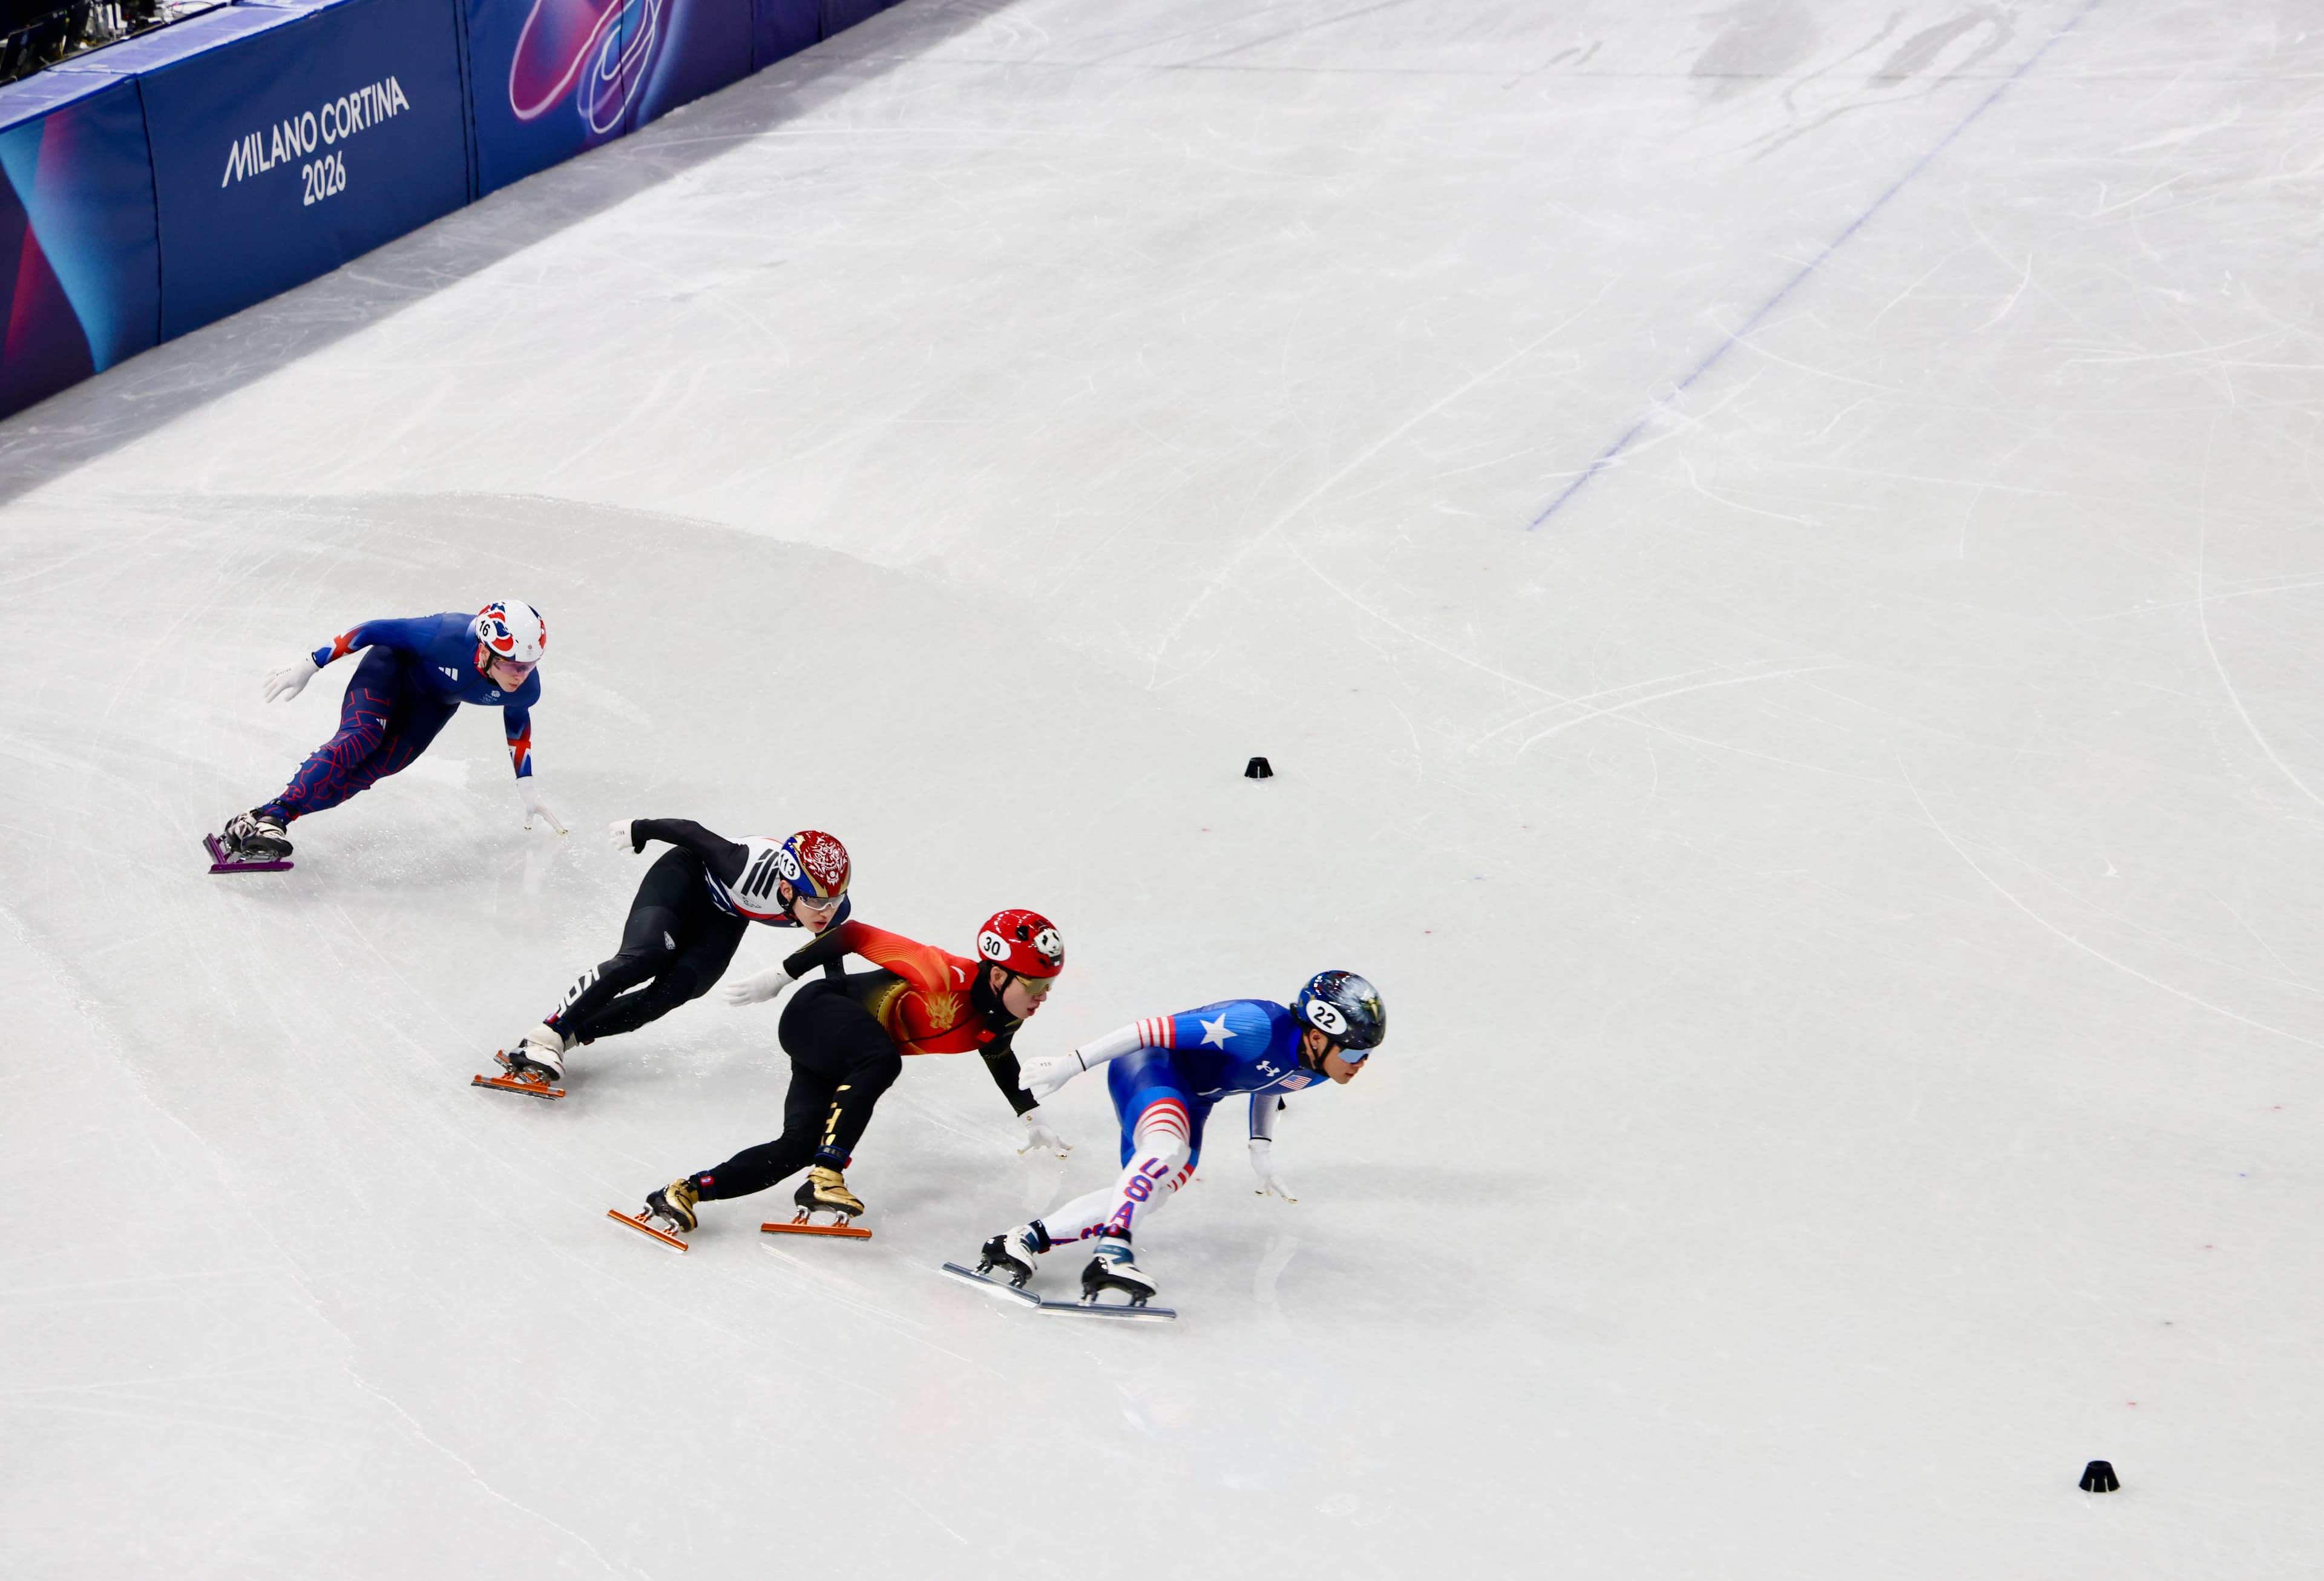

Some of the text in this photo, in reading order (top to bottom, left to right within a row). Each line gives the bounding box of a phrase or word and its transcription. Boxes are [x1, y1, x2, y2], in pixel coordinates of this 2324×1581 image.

[222, 76, 410, 188] MILANO CORTINA
[302, 150, 346, 206] 2026
[479, 620, 491, 637] 16
[780, 853, 796, 877] 113
[983, 936, 1000, 956] 30
[1313, 1006, 1336, 1029] 22
[1109, 1157, 1170, 1229] USA
